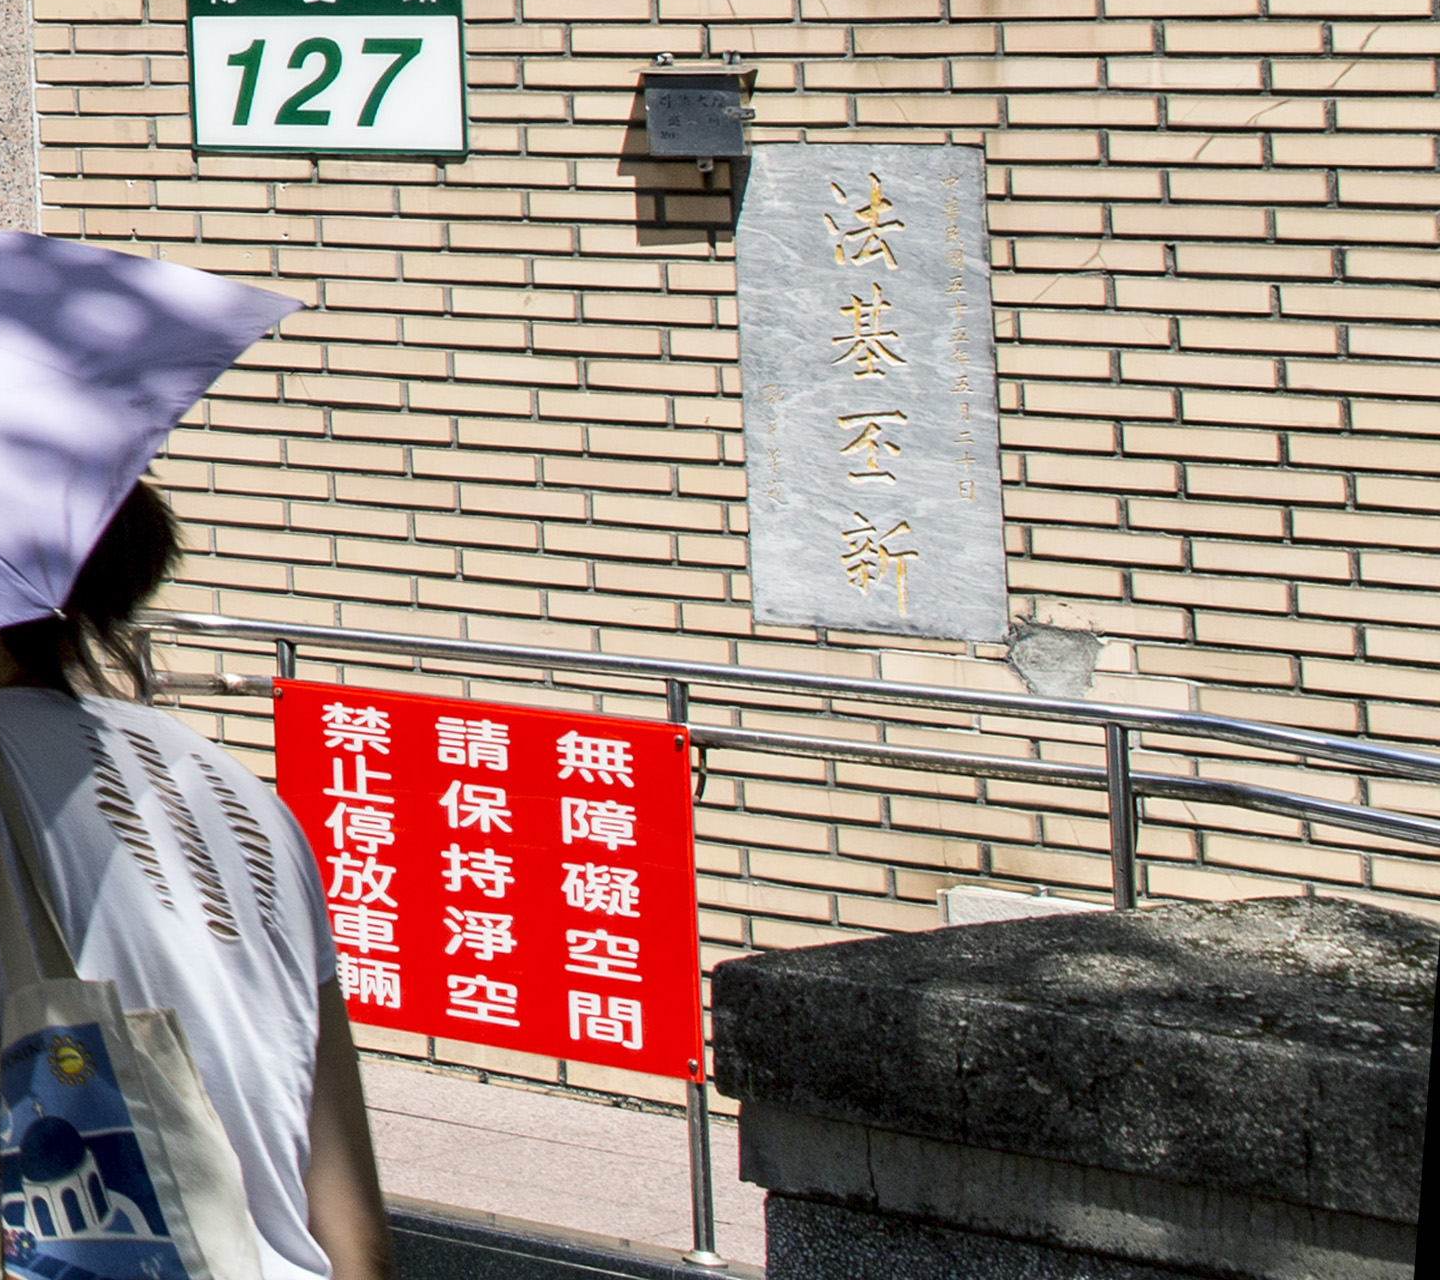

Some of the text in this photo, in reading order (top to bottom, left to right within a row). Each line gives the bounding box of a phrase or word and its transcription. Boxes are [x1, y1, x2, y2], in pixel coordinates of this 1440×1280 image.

[226, 37, 424, 128] 127
[823, 171, 920, 616] 法基丕新
[939, 172, 978, 502] 中華民國五十五年五月二十日
[320, 702, 402, 1010] 禁止停放車輛
[435, 716, 521, 1028] 請保持淨空
[556, 730, 644, 1050] 無障礙空間
